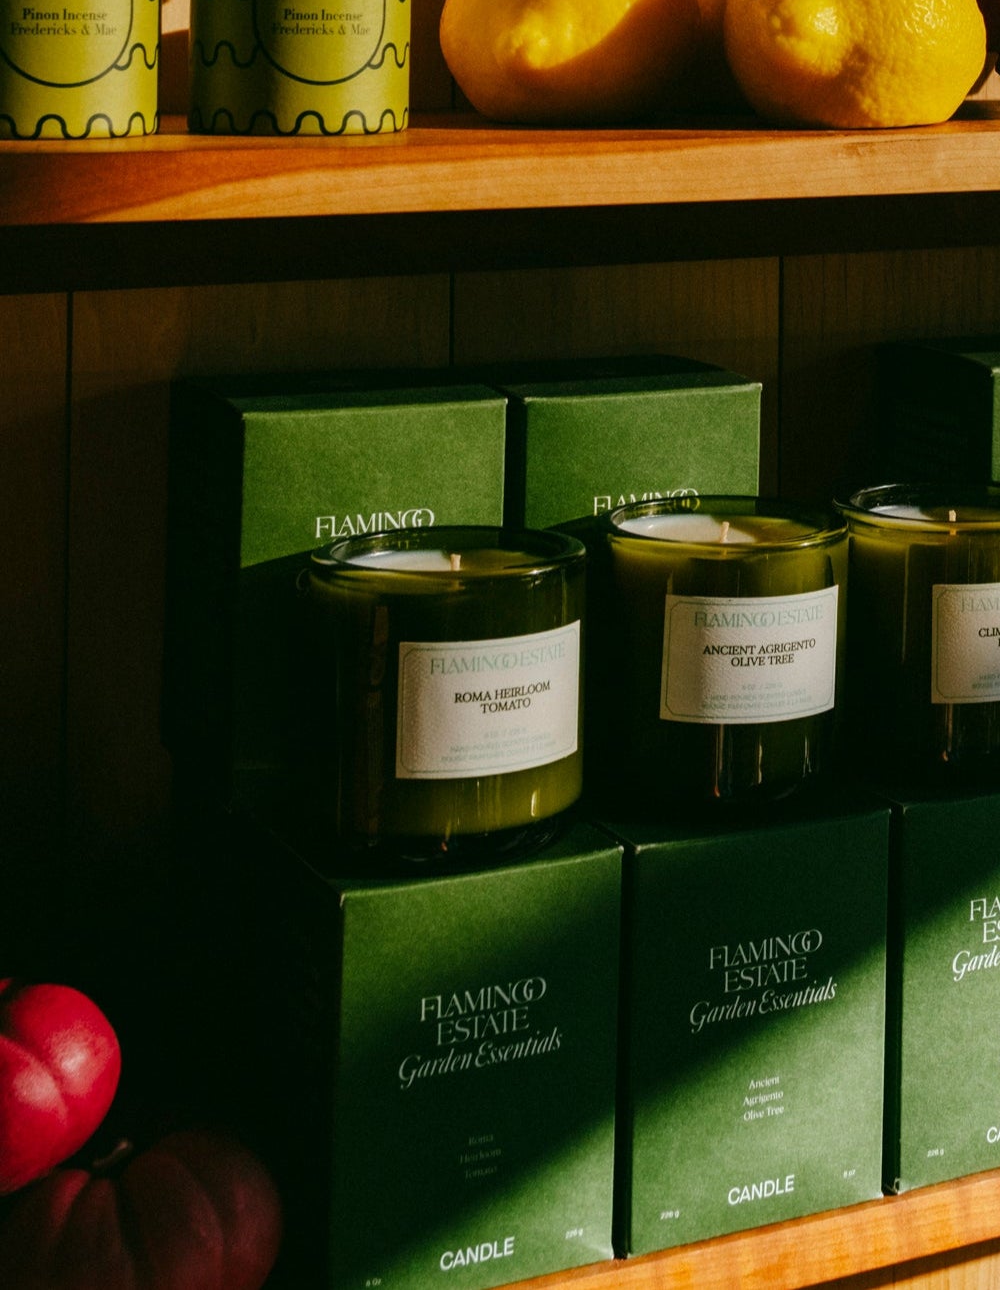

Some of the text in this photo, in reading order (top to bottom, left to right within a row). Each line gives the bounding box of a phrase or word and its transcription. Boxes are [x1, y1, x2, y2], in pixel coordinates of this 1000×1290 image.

[23, 8, 107, 21] Pinon Incense
[284, 8, 363, 21] Pinon Incense
[11, 22, 77, 36] Fredericks
[81, 24, 90, 36] &
[338, 25, 346, 35] &
[315, 508, 435, 538] FLAMINGO
[694, 611, 775, 628] FLAMINGO
[702, 638, 816, 656] ANCIENT AGRIGENTO
[430, 651, 518, 676] FLAMINGO
[731, 653, 795, 668] OLIVE TREE
[454, 680, 551, 704] ROMA HEIRLOOM
[480, 698, 531, 714] TOMATO
[708, 928, 823, 970] FLAMINGO
[724, 957, 808, 993] ESTATE
[420, 976, 547, 1022] FLAMINGO
[689, 976, 838, 1034] Garden Essentials
[437, 1006, 530, 1046] ESTATE
[398, 1027, 563, 1090] Garden Essentials
[748, 1074, 781, 1090] Ancient
[742, 1090, 784, 1107] Agrigento
[743, 1105, 785, 1122] Olive Tree
[727, 1174, 796, 1206] CANDLE
[439, 1236, 516, 1272] CANDLE
